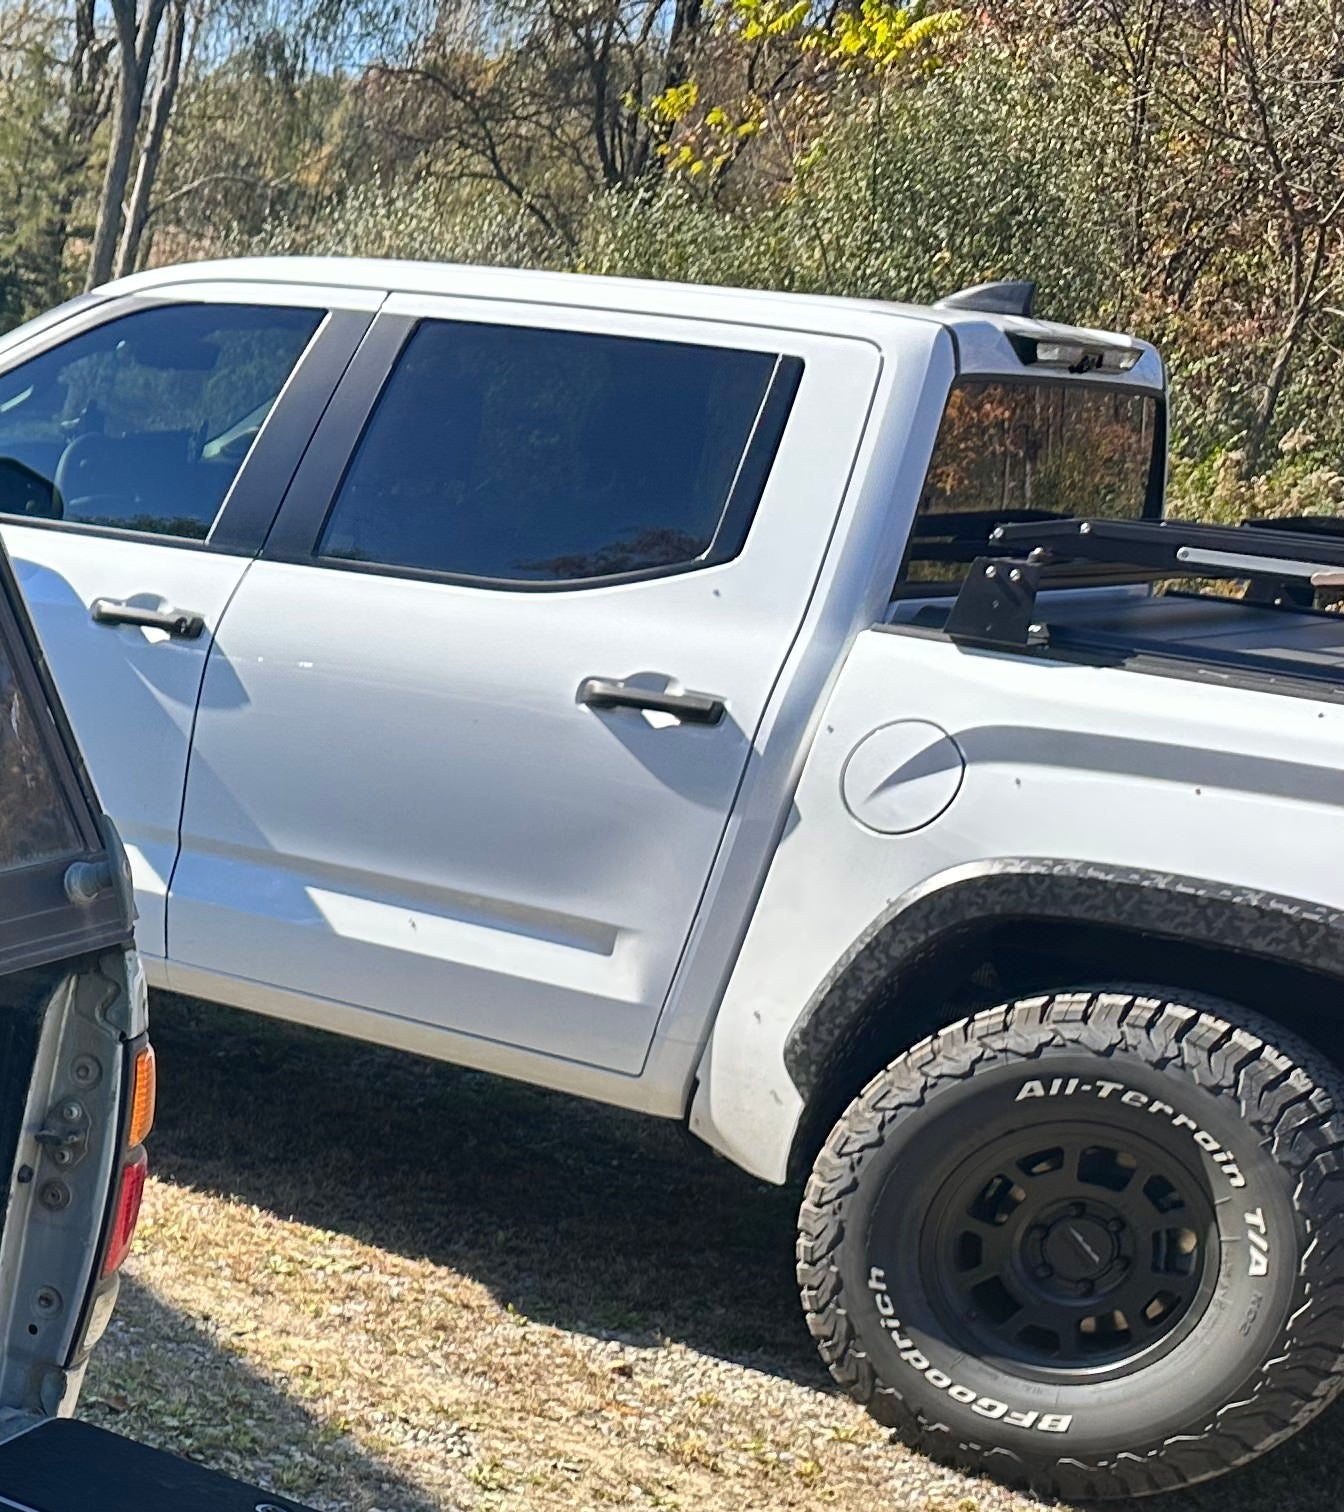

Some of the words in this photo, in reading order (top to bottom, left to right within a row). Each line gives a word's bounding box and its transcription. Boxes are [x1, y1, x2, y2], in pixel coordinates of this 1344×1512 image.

[1014, 1078, 1246, 1188] All-Terrain
[1243, 1206, 1269, 1277] T/A
[867, 1265, 1074, 1433] BFGoodrich
